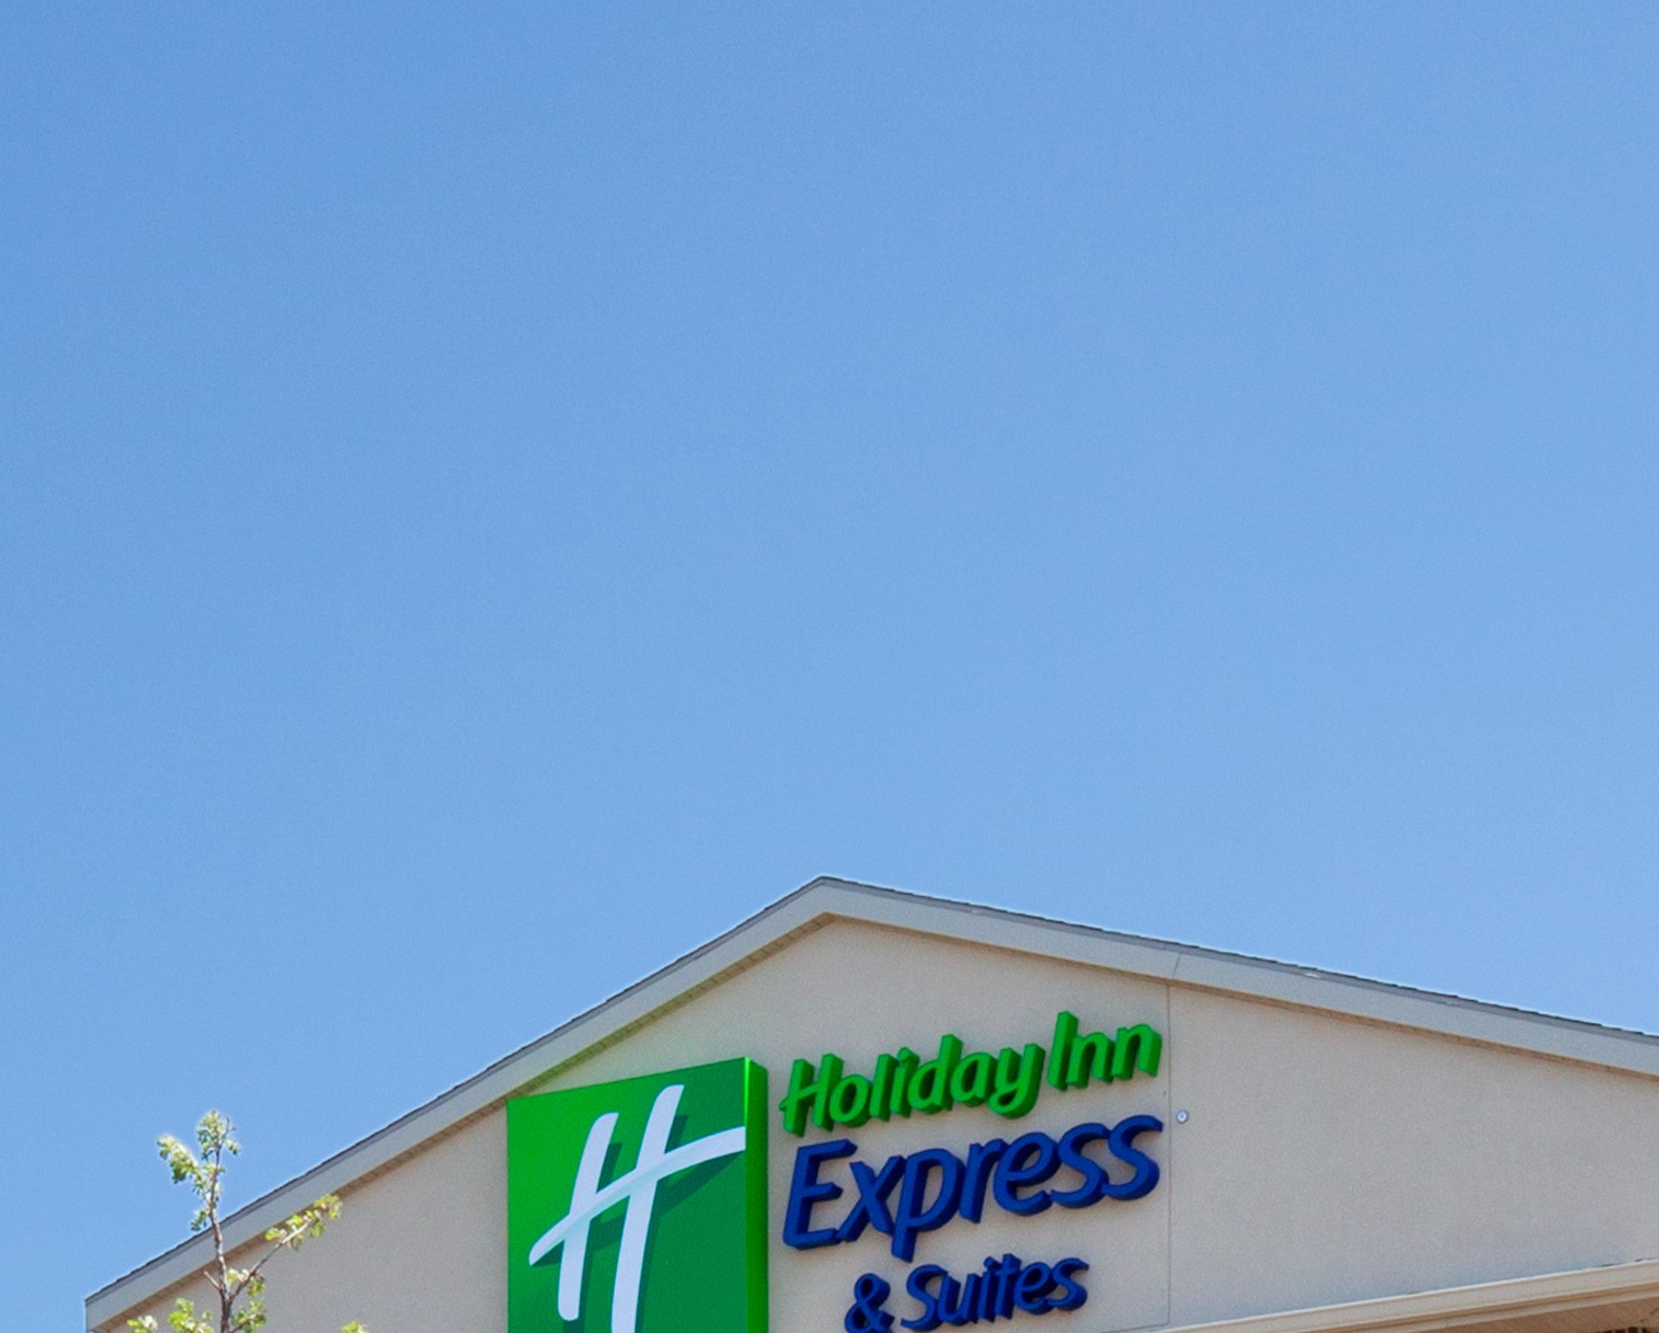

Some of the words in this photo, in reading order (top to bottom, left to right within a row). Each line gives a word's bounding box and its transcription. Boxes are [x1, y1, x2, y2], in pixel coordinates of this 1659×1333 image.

[779, 1033, 1044, 1137] Holiday
[1046, 1010, 1163, 1091] Inn
[781, 1114, 1164, 1263] Express
[901, 1253, 1090, 1333] Suites
